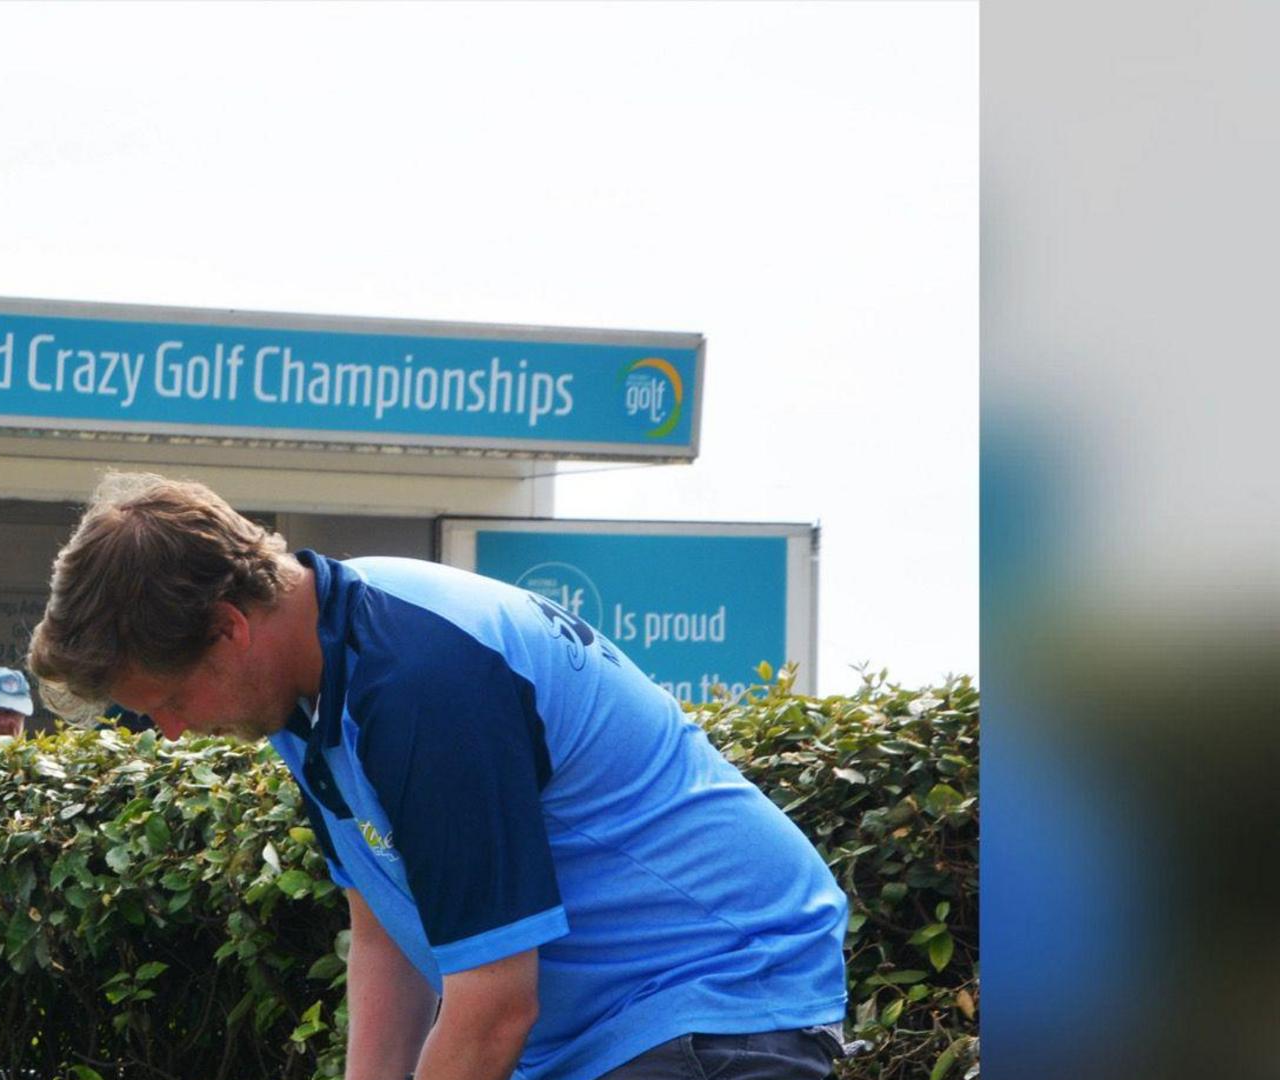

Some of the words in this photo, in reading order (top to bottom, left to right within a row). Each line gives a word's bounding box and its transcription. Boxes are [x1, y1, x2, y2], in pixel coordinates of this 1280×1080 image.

[27, 333, 145, 408] Crazy
[154, 340, 245, 401] Golf
[253, 345, 575, 427] Championships
[614, 602, 637, 641] Is
[643, 605, 726, 650] proud
